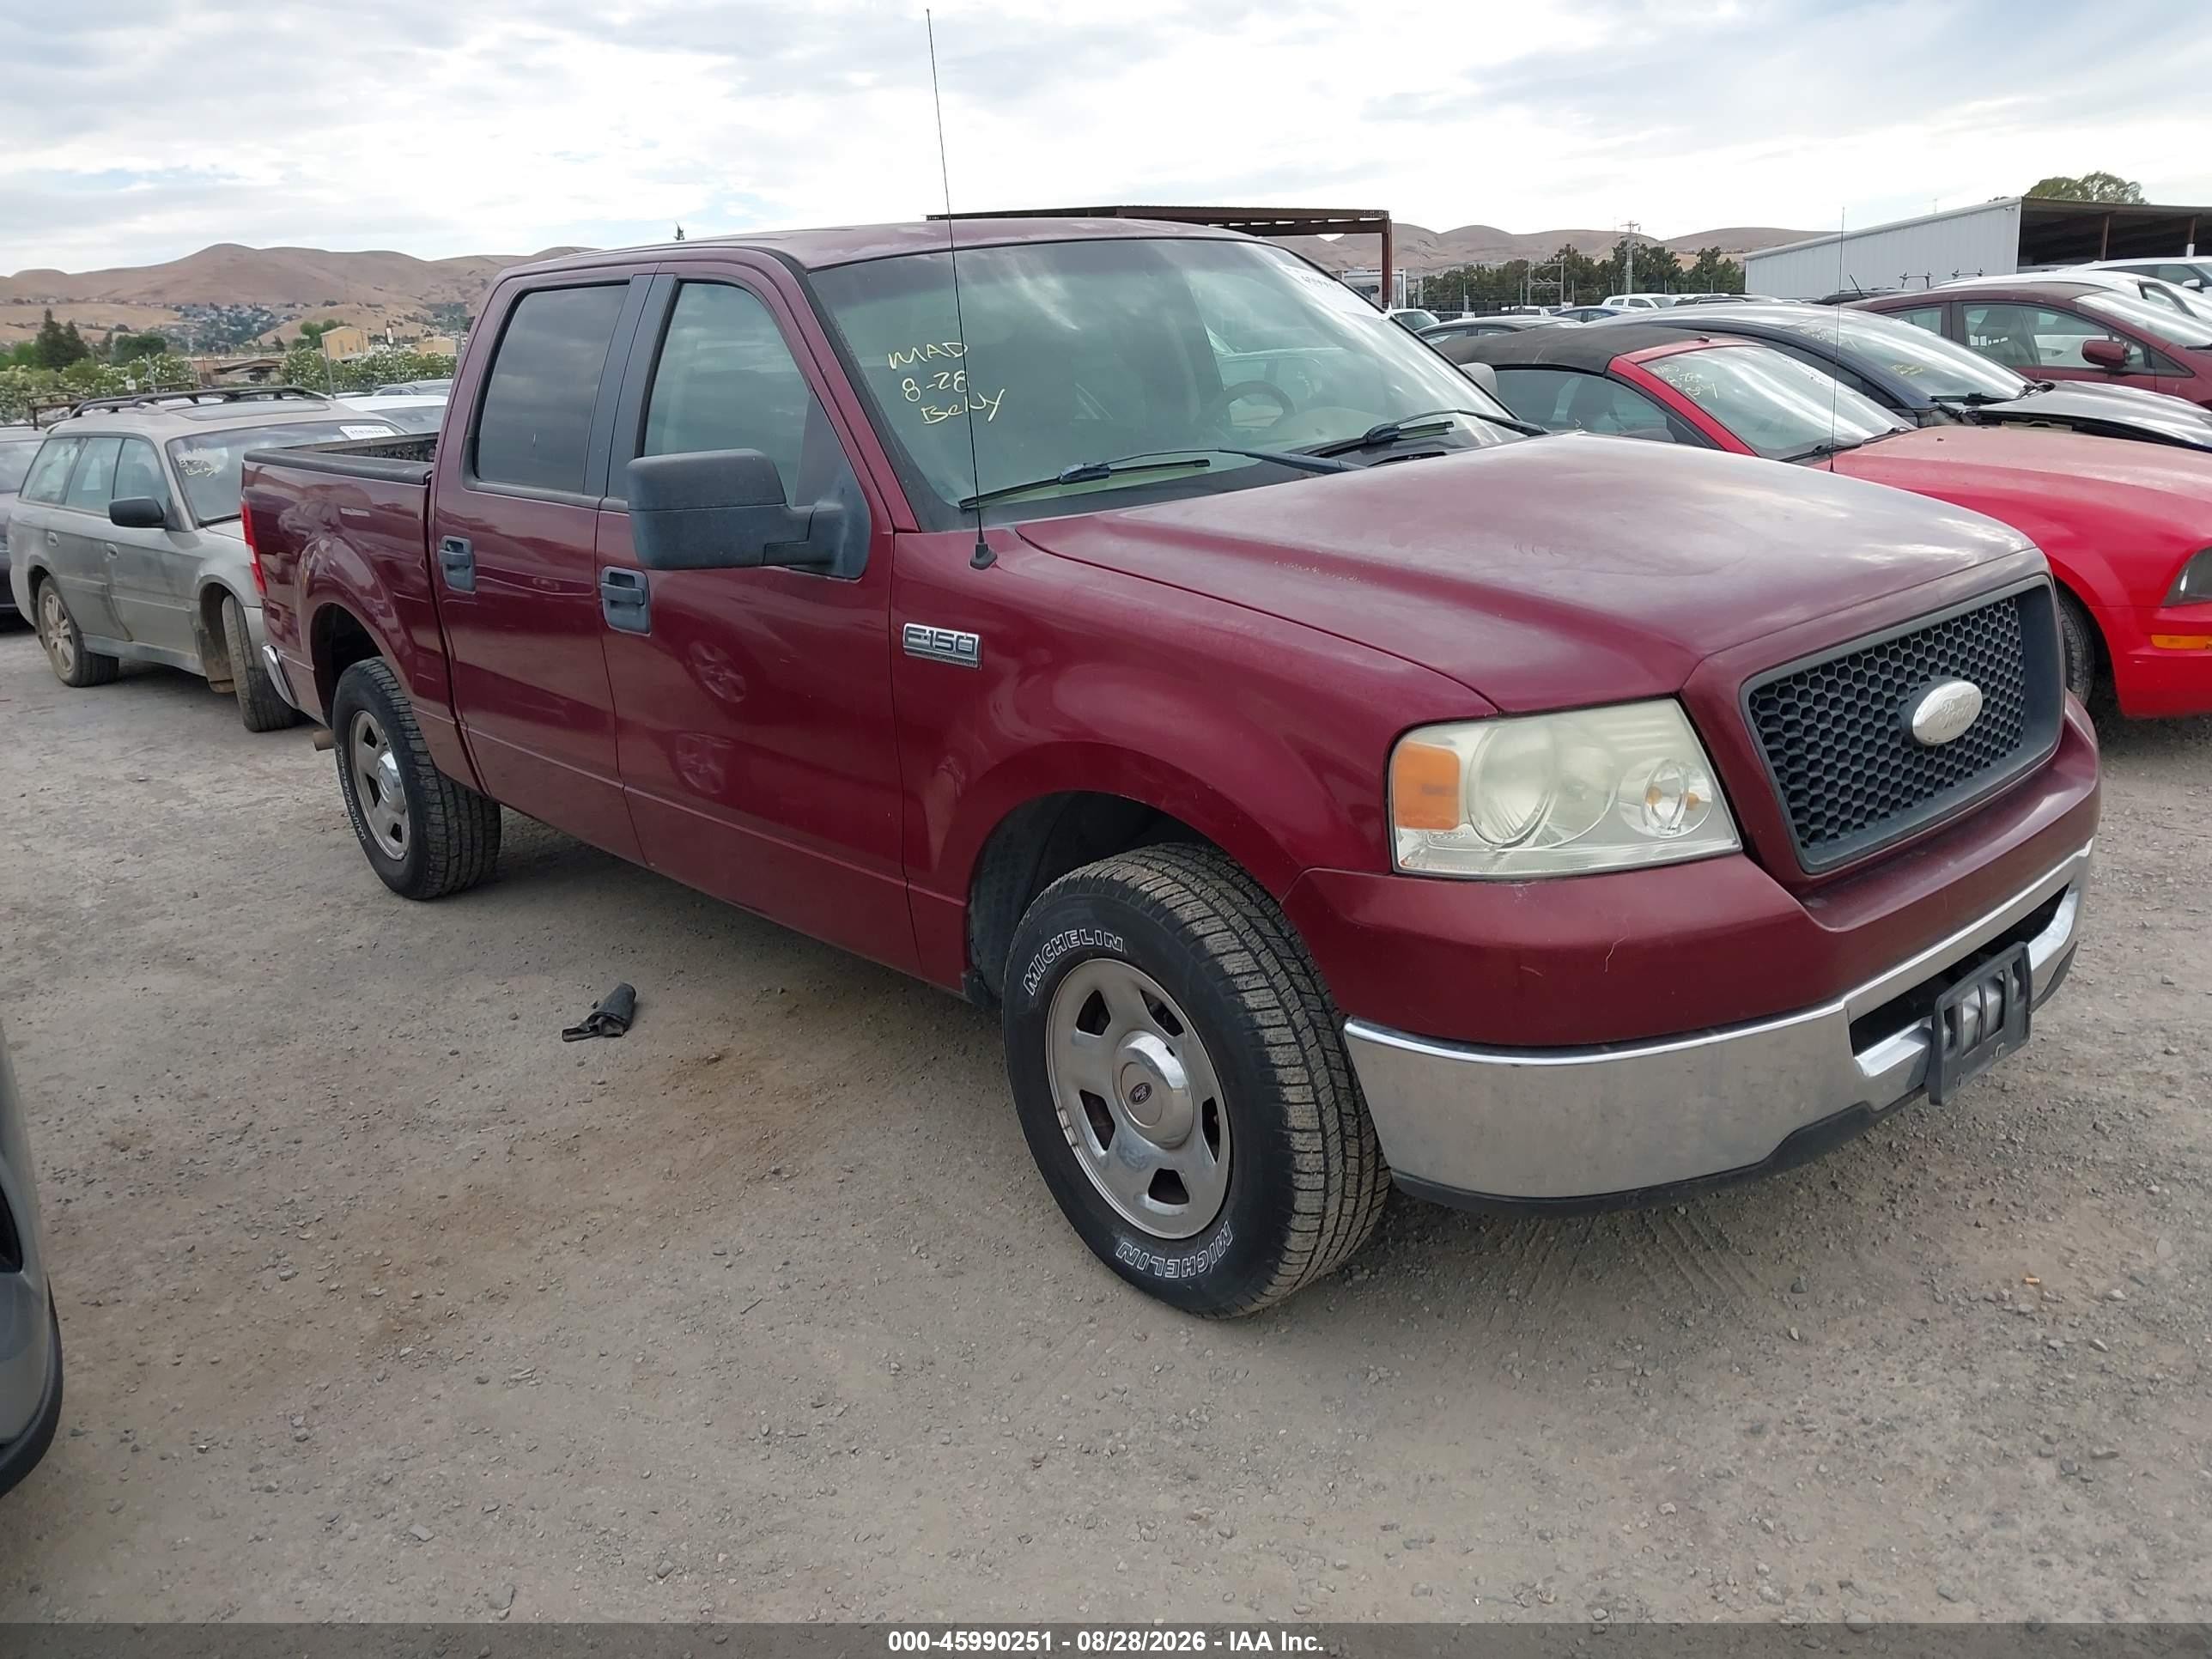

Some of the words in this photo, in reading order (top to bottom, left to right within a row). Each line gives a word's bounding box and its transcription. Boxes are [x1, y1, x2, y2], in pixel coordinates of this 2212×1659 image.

[902, 370, 969, 403] 8-28
[1023, 928, 1123, 996] MICHELIN
[1115, 1219, 1234, 1279] MICHELIN
